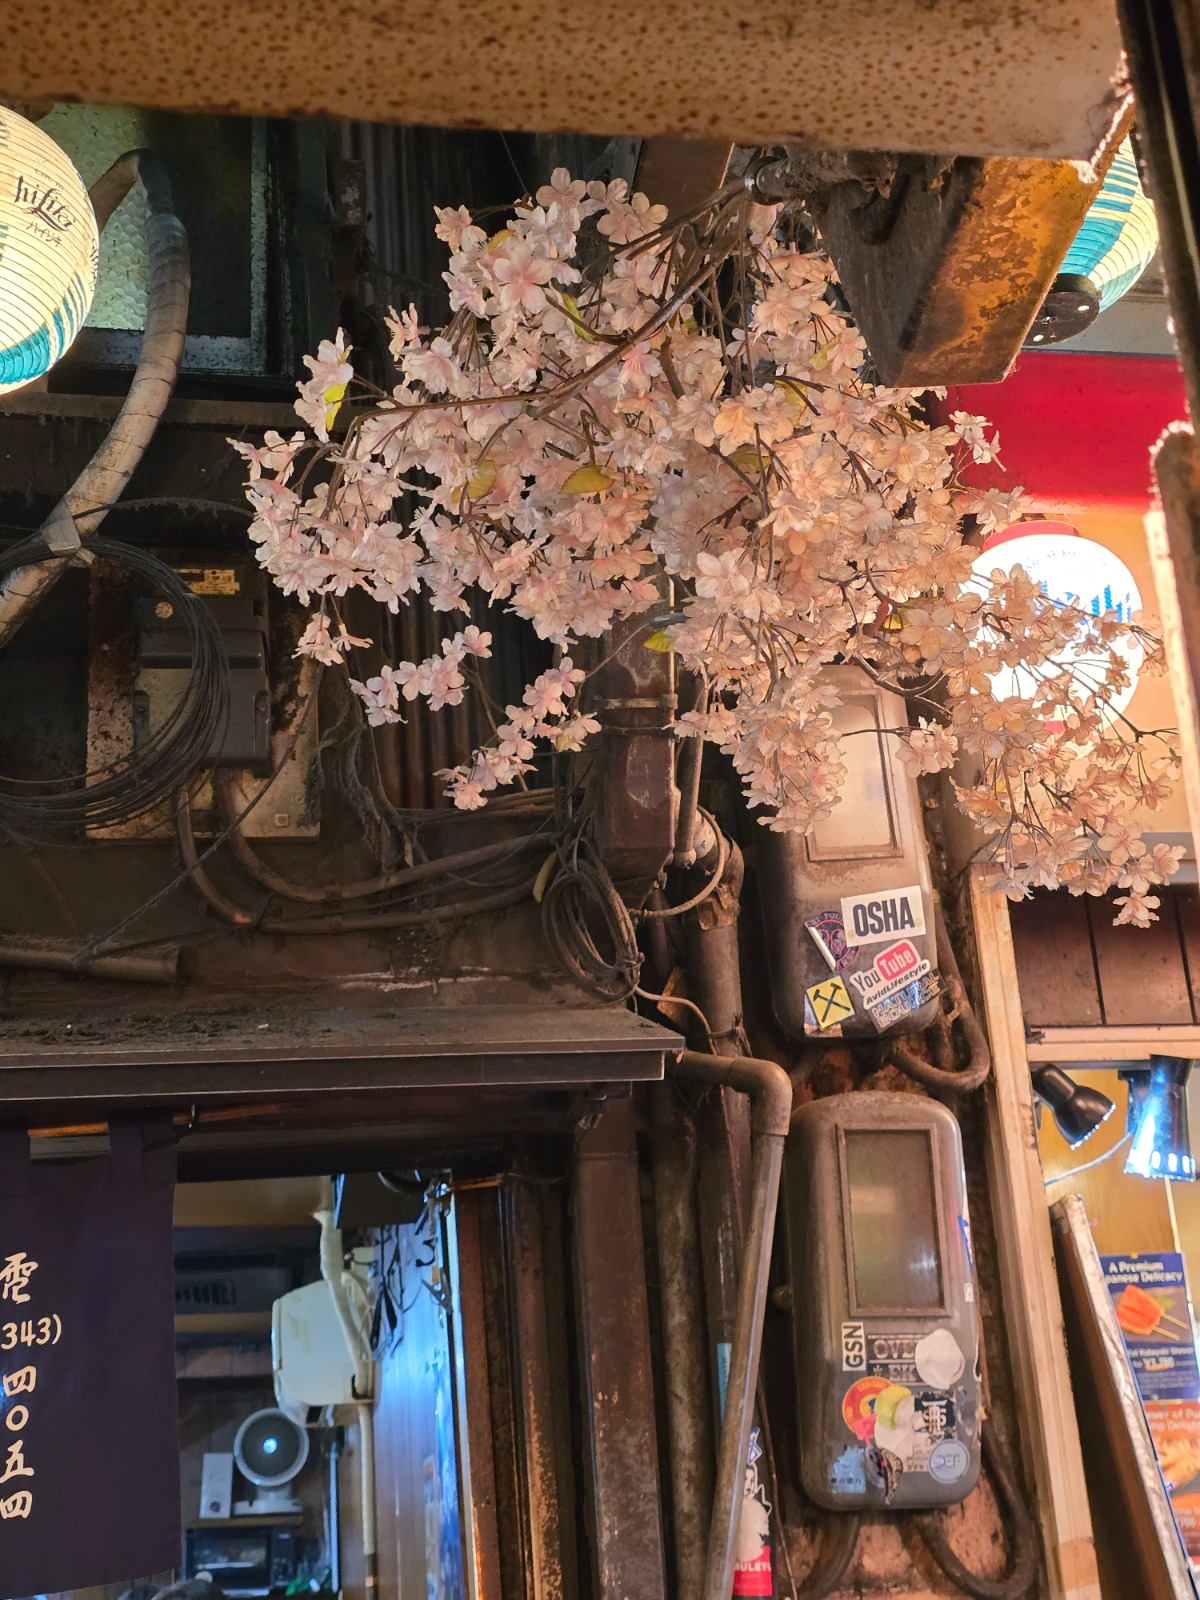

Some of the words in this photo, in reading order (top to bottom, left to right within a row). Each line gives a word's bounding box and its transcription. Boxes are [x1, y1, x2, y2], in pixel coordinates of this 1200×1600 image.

[852, 896, 915, 937] OSHA
[853, 970, 881, 992] You
[879, 949, 914, 977] Tube
[1108, 1262, 1118, 1273] A
[1119, 1261, 1164, 1273] Premium
[1141, 1271, 1182, 1283] Delicacy
[842, 1325, 864, 1368] GSN
